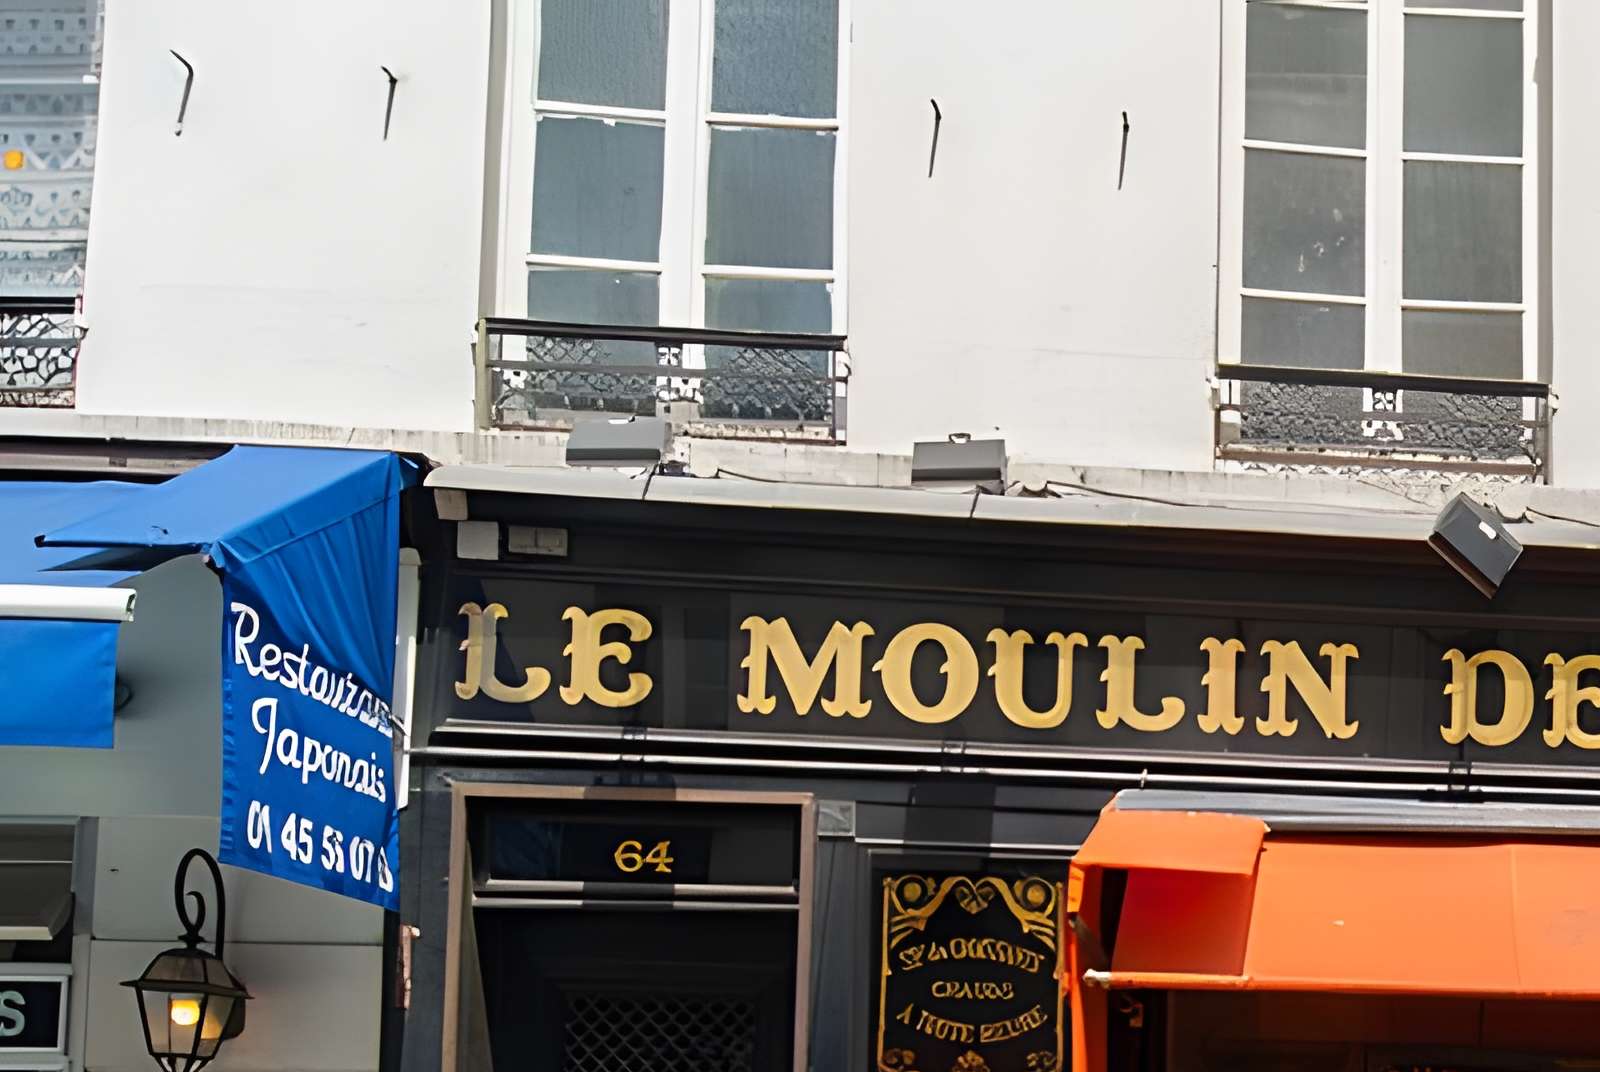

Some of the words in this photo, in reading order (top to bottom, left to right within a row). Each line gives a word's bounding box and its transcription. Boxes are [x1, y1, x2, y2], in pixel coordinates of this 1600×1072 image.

[455, 602, 653, 709] LE
[737, 615, 1360, 739] MOULIN
[247, 800, 273, 854] 01
[281, 812, 313, 866] 45
[614, 840, 674, 872] 64
